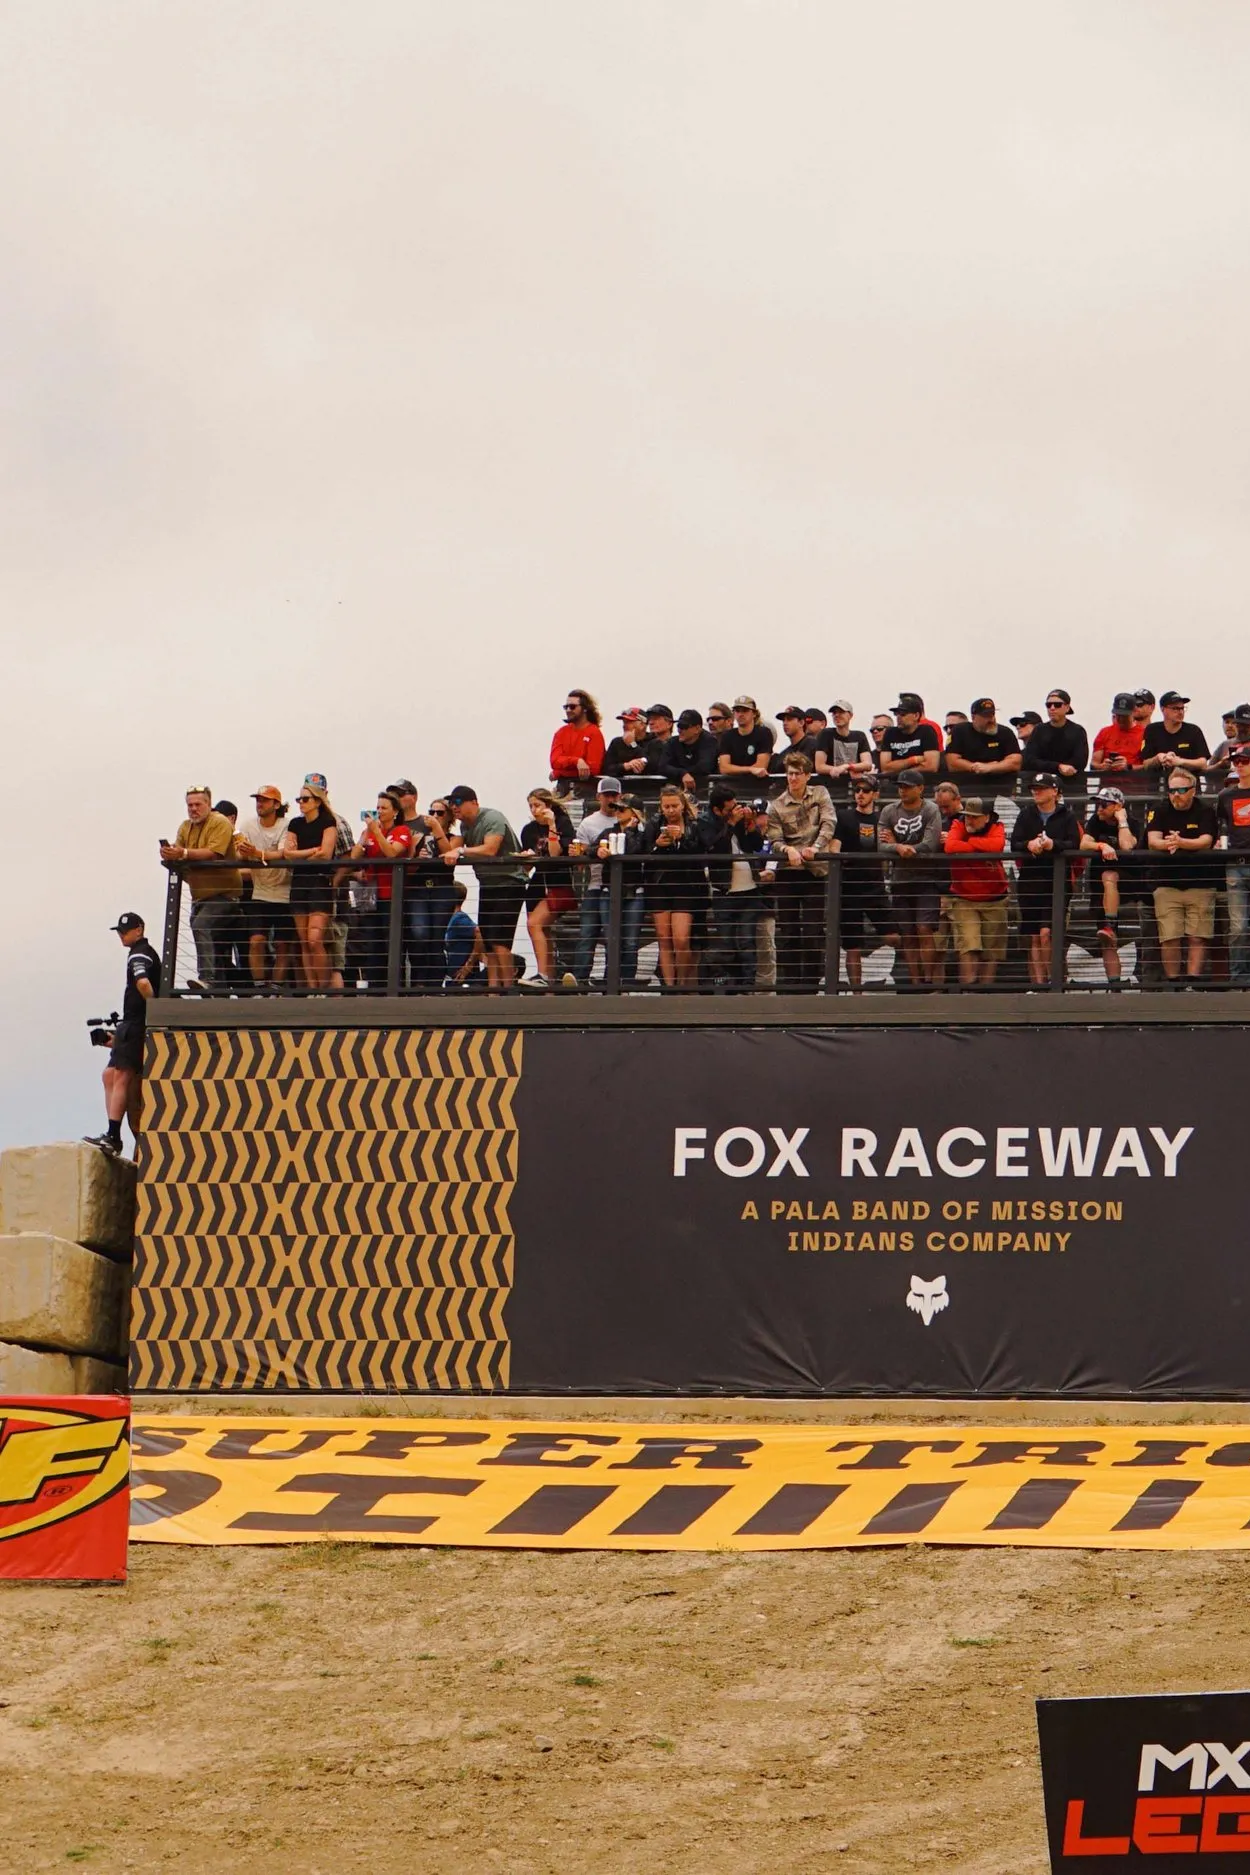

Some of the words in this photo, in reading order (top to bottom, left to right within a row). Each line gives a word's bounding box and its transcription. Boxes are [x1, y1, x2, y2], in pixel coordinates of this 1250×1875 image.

[673, 1126, 811, 1178] FOX
[840, 1126, 1195, 1178] RACEWAY
[741, 1200, 759, 1220] A
[770, 1200, 841, 1221] PALA
[852, 1200, 931, 1221] BAND
[941, 1200, 979, 1221] OF
[991, 1200, 1123, 1221] MISSION
[788, 1231, 915, 1252] INDIANS
[926, 1231, 1071, 1252] COMPANY
[131, 1426, 764, 1469] SUPER
